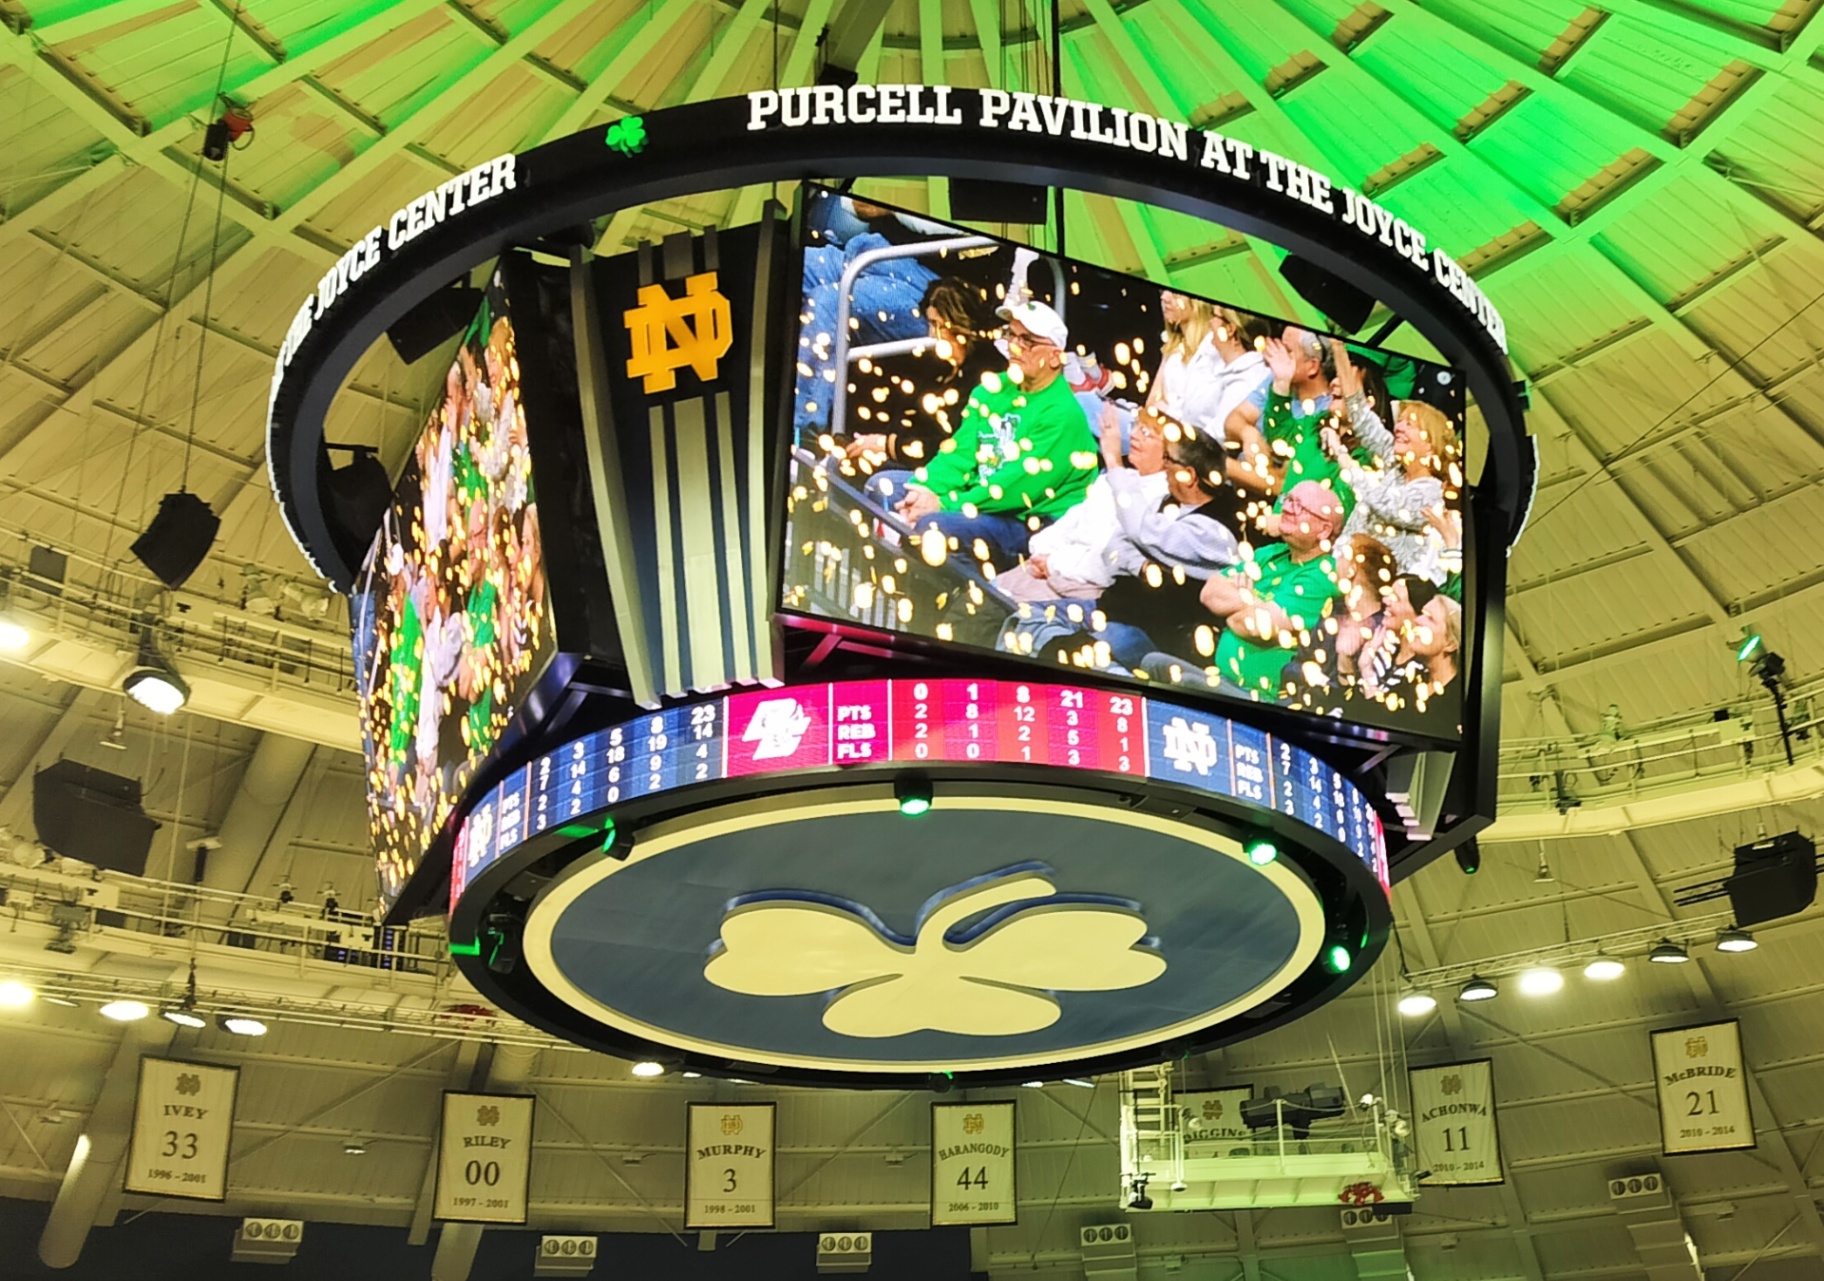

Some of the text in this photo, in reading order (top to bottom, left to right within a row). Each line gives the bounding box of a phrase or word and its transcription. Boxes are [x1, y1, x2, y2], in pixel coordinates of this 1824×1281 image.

[747, 84, 1508, 355] PURCELL PAVILION AT THE JOYCE CENTER
[314, 225, 382, 320] JOYCE
[388, 153, 516, 250] CENTER
[914, 683, 1133, 716] 0 1 8 21 23
[837, 703, 1128, 733] PTS 2 8 12 3 8
[540, 705, 716, 775] 2 3 5 8 23
[837, 723, 1129, 752] REB 2 1 2 5 1
[540, 775, 549, 791] 7
[571, 760, 586, 778] 14
[606, 746, 625, 763] 18
[648, 734, 668, 751] 19
[693, 723, 713, 740] 14
[837, 743, 1130, 772] FLS 0 0 1 3 3
[1280, 743, 1291, 760] 2
[538, 794, 548, 811] 2
[572, 780, 582, 795] 4
[608, 767, 620, 783] 6
[650, 755, 662, 771] 9
[696, 744, 708, 759] 4
[1281, 760, 1291, 775] 7
[1309, 776, 1322, 793] 14
[1283, 781, 1293, 797] 2
[537, 814, 546, 830] 3
[570, 798, 581, 815] 2
[607, 786, 620, 803] 0
[649, 774, 661, 790] 2
[695, 763, 708, 780] 2
[1285, 799, 1294, 815] 3
[1314, 812, 1323, 829] 2
[1664, 1066, 1737, 1086] McBRIDE
[163, 1105, 208, 1120] IVEY
[1422, 1103, 1487, 1122] ACHONWA
[1686, 1090, 1720, 1116] 21
[162, 1131, 198, 1159] 33
[463, 1136, 511, 1149] RILEY
[938, 1143, 1010, 1161] HARANGODY
[1442, 1126, 1471, 1152] 11
[697, 1145, 766, 1160] MURPHY
[181, 1173, 206, 1183] 2001
[465, 1160, 500, 1186] 00
[723, 1168, 737, 1192] 3
[956, 1166, 989, 1190] 44
[453, 1197, 476, 1207] 1997
[486, 1199, 509, 1209] 2001
[734, 1204, 756, 1214] 2001
